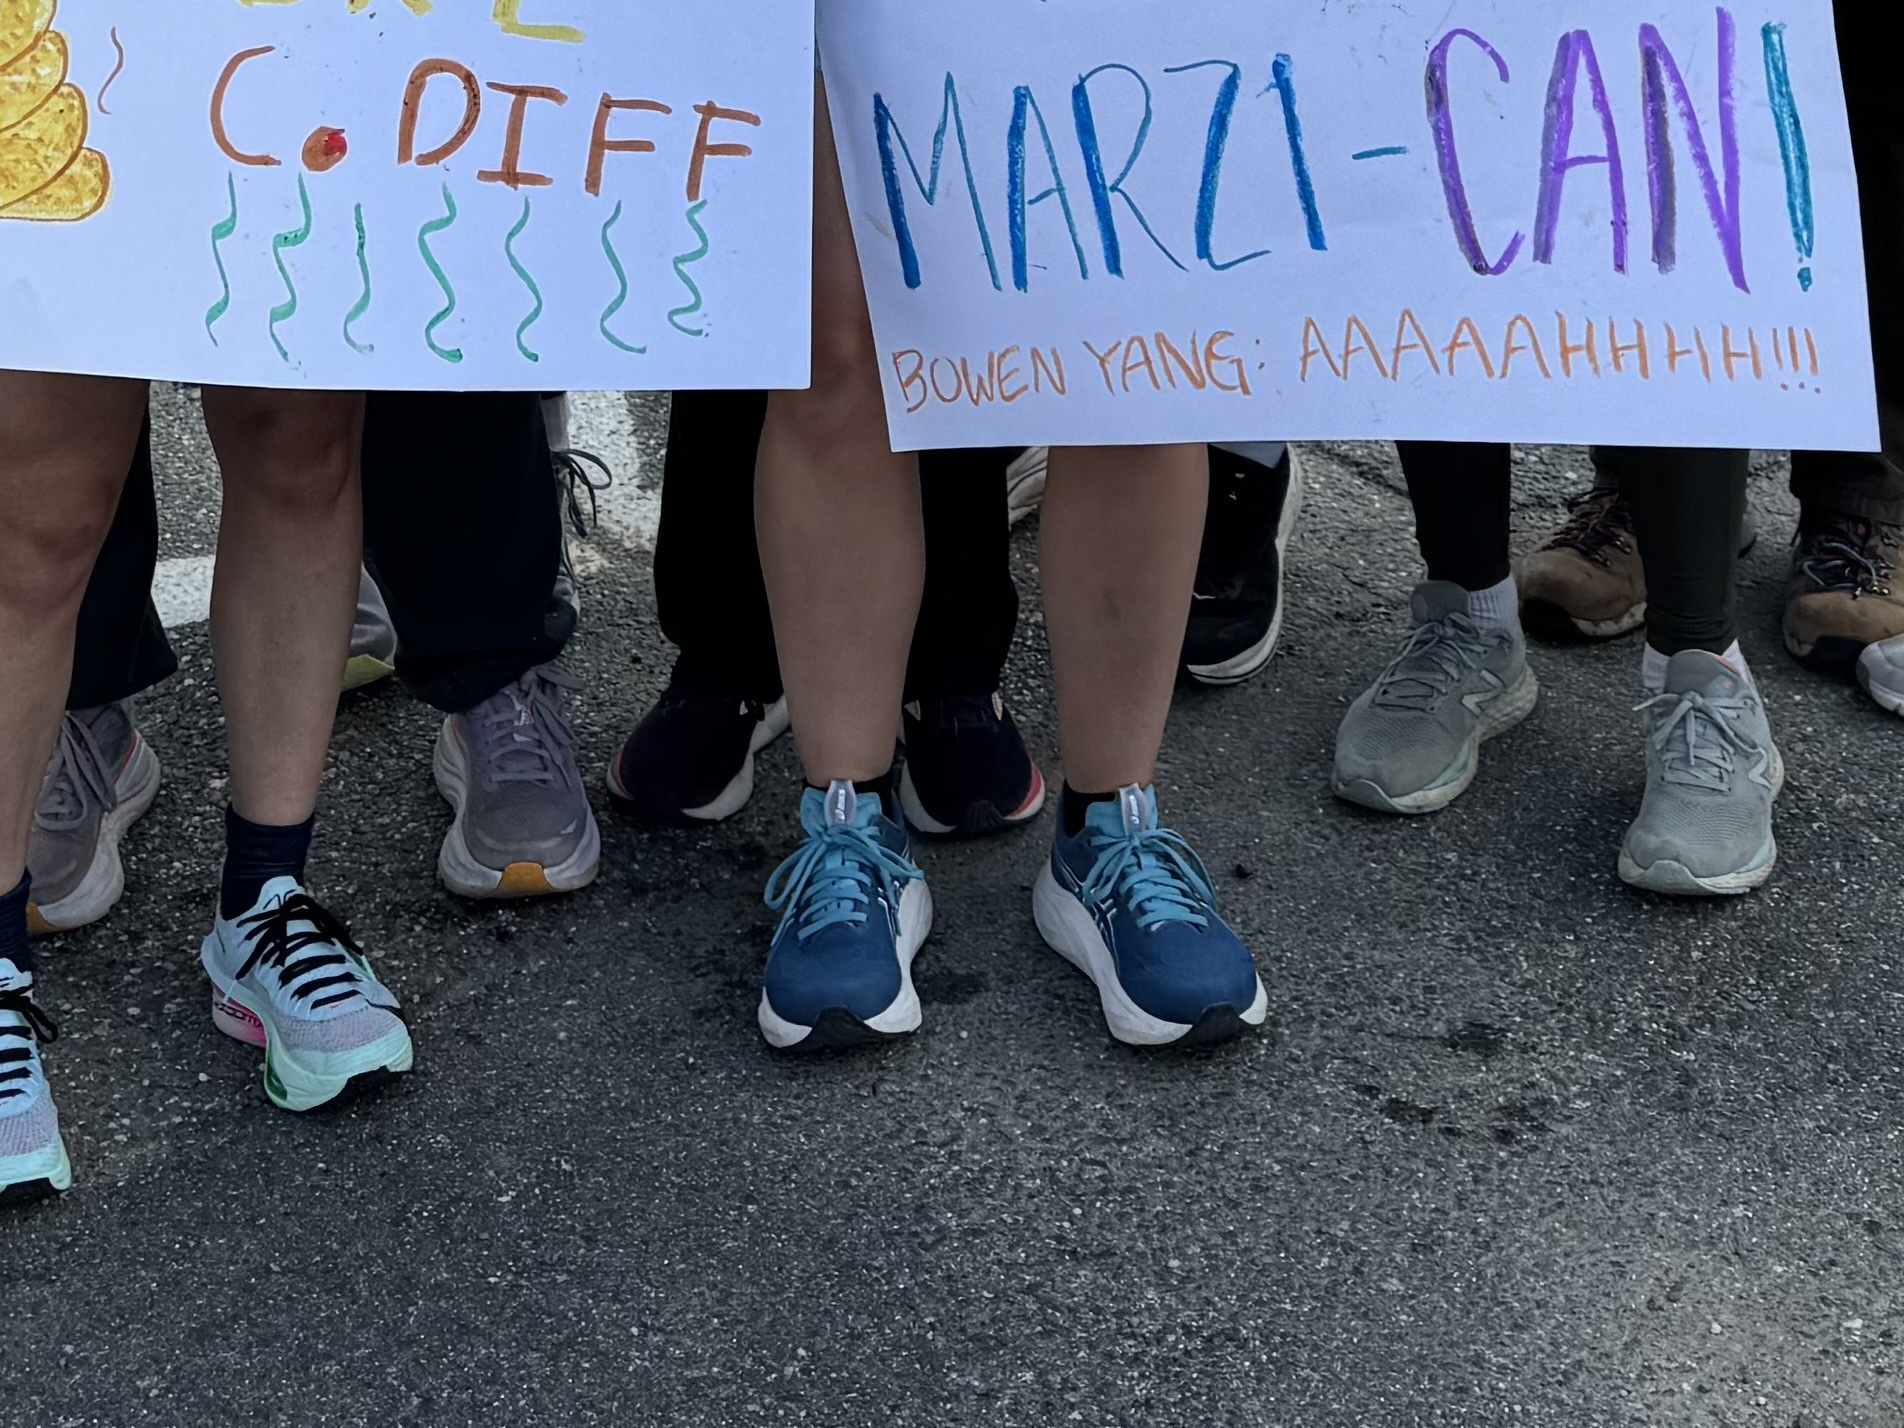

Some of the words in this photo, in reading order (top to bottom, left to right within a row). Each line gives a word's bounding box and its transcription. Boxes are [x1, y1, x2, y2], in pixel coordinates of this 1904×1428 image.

[873, 6, 1815, 293] MARZI-CAN!
[891, 344, 1068, 412] BOWEN
[1084, 328, 1266, 398] YANG:
